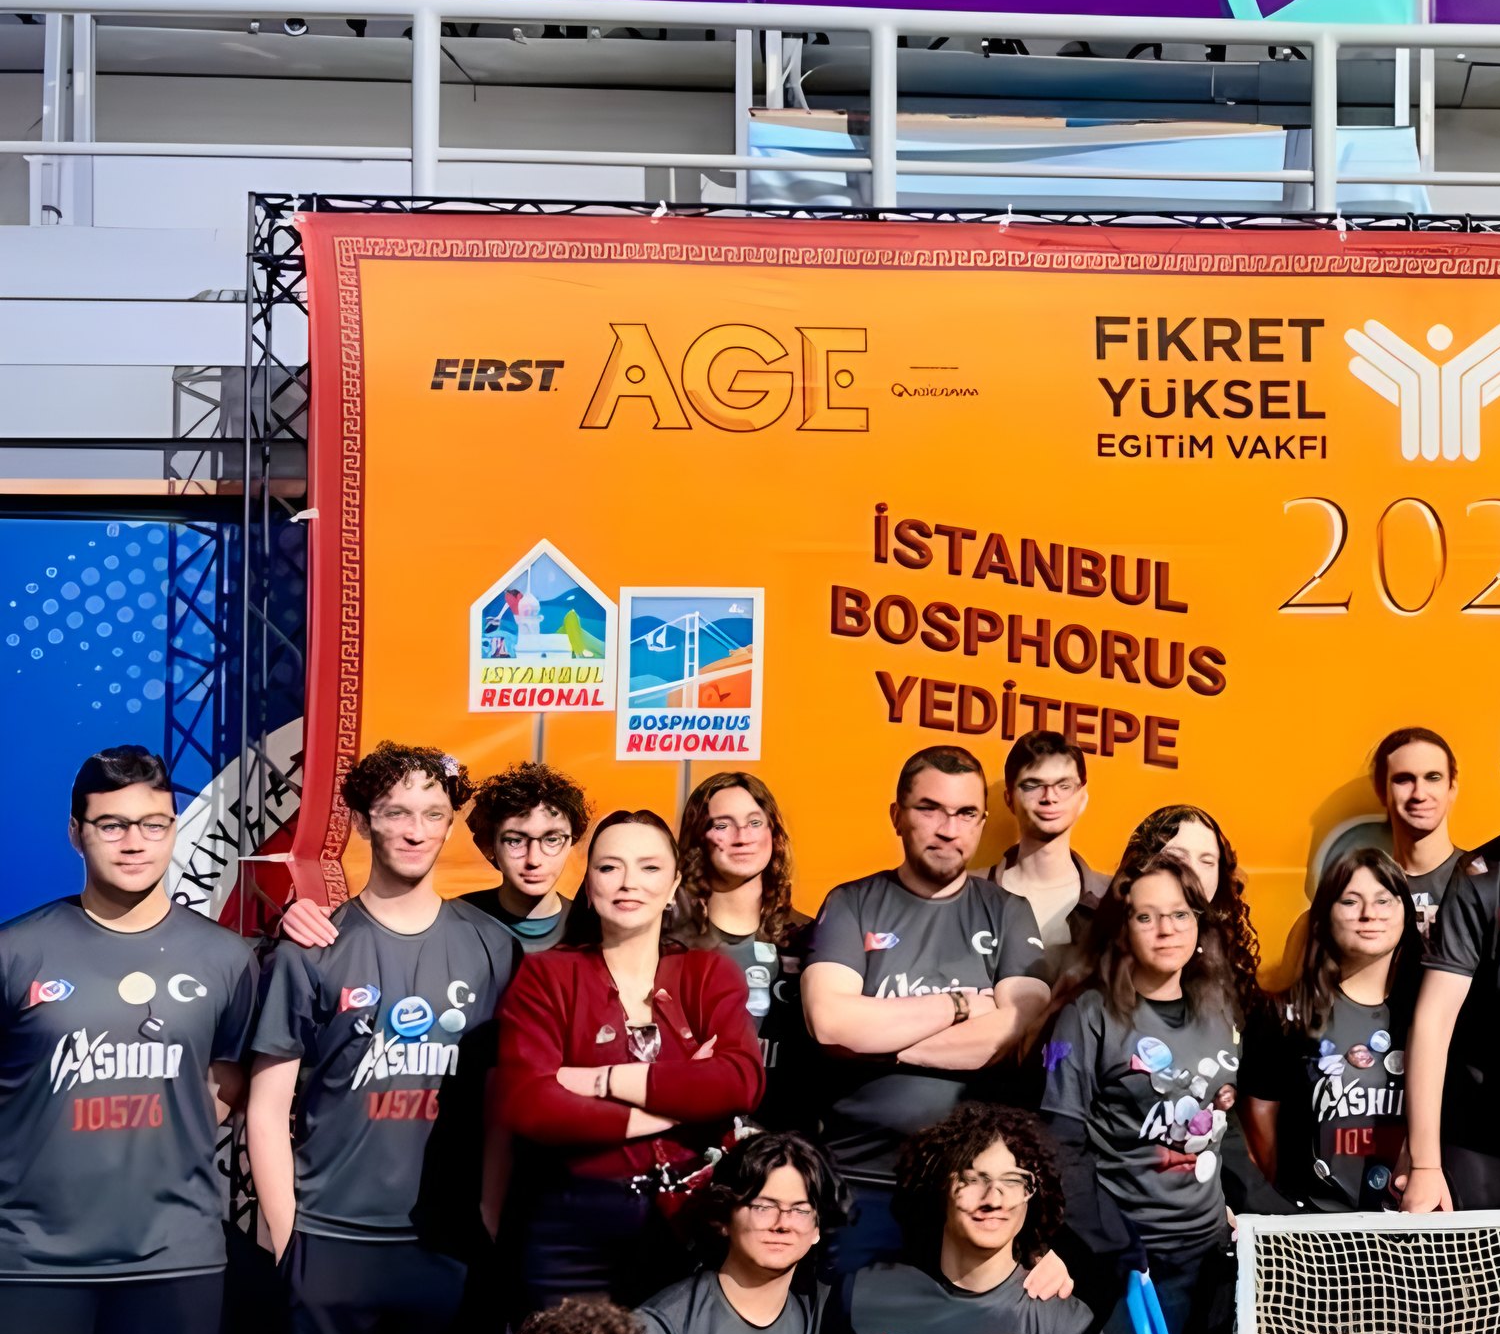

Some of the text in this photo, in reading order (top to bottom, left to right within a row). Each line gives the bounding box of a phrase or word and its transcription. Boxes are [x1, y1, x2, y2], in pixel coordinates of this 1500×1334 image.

[579, 323, 869, 433] AGE
[1097, 377, 1326, 419] YÜKSEL
[1226, 435, 1327, 459] VAKFI
[873, 501, 1189, 614] İSTANBUL
[830, 584, 1227, 697] BOSPHORUS
[481, 688, 604, 707] REGIONAL
[874, 670, 1180, 770] YEDİTEPE
[626, 734, 750, 753] REGIONAL
